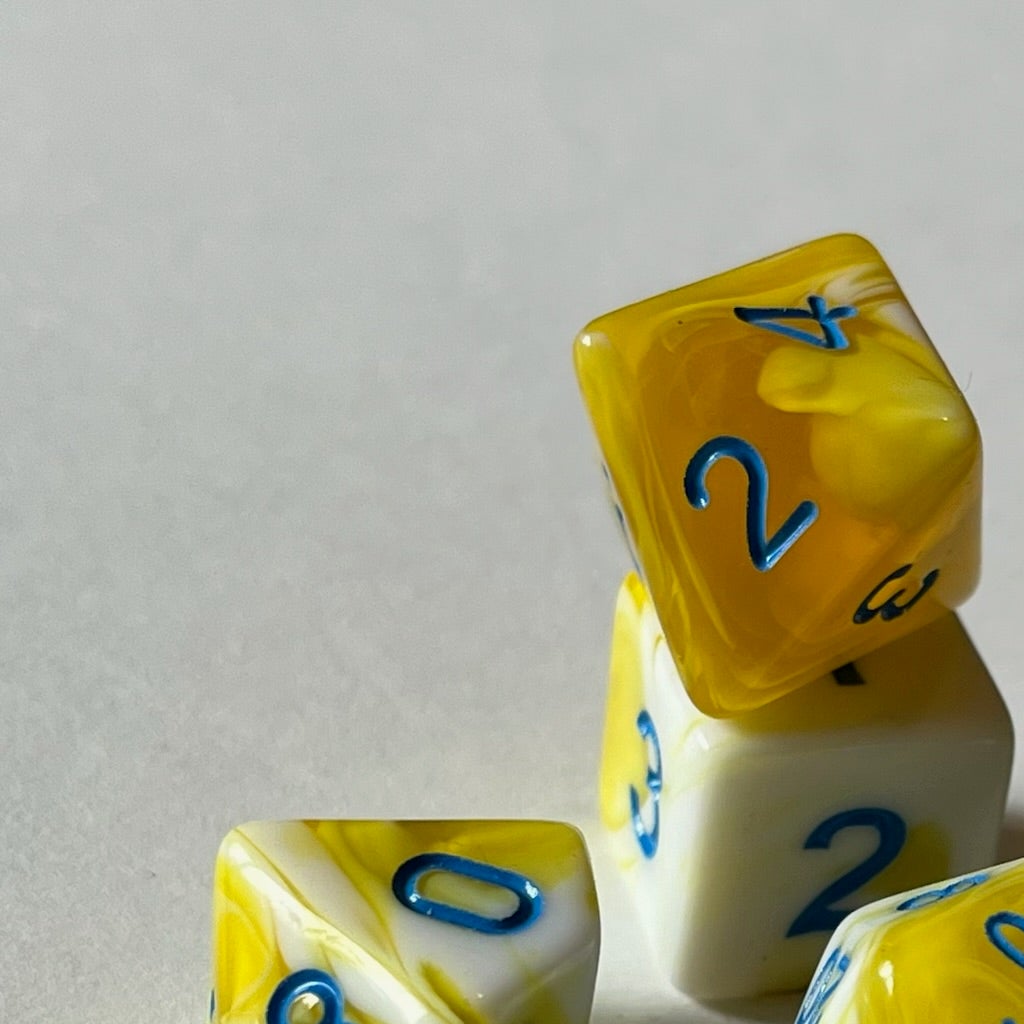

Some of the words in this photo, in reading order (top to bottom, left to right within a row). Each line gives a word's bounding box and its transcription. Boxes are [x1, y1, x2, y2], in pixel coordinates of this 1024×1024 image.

[733, 295, 859, 350] 4
[683, 435, 820, 573] 2
[852, 563, 941, 625] 3
[630, 709, 664, 860] 3
[392, 852, 546, 936] 0
[785, 806, 909, 940] 2
